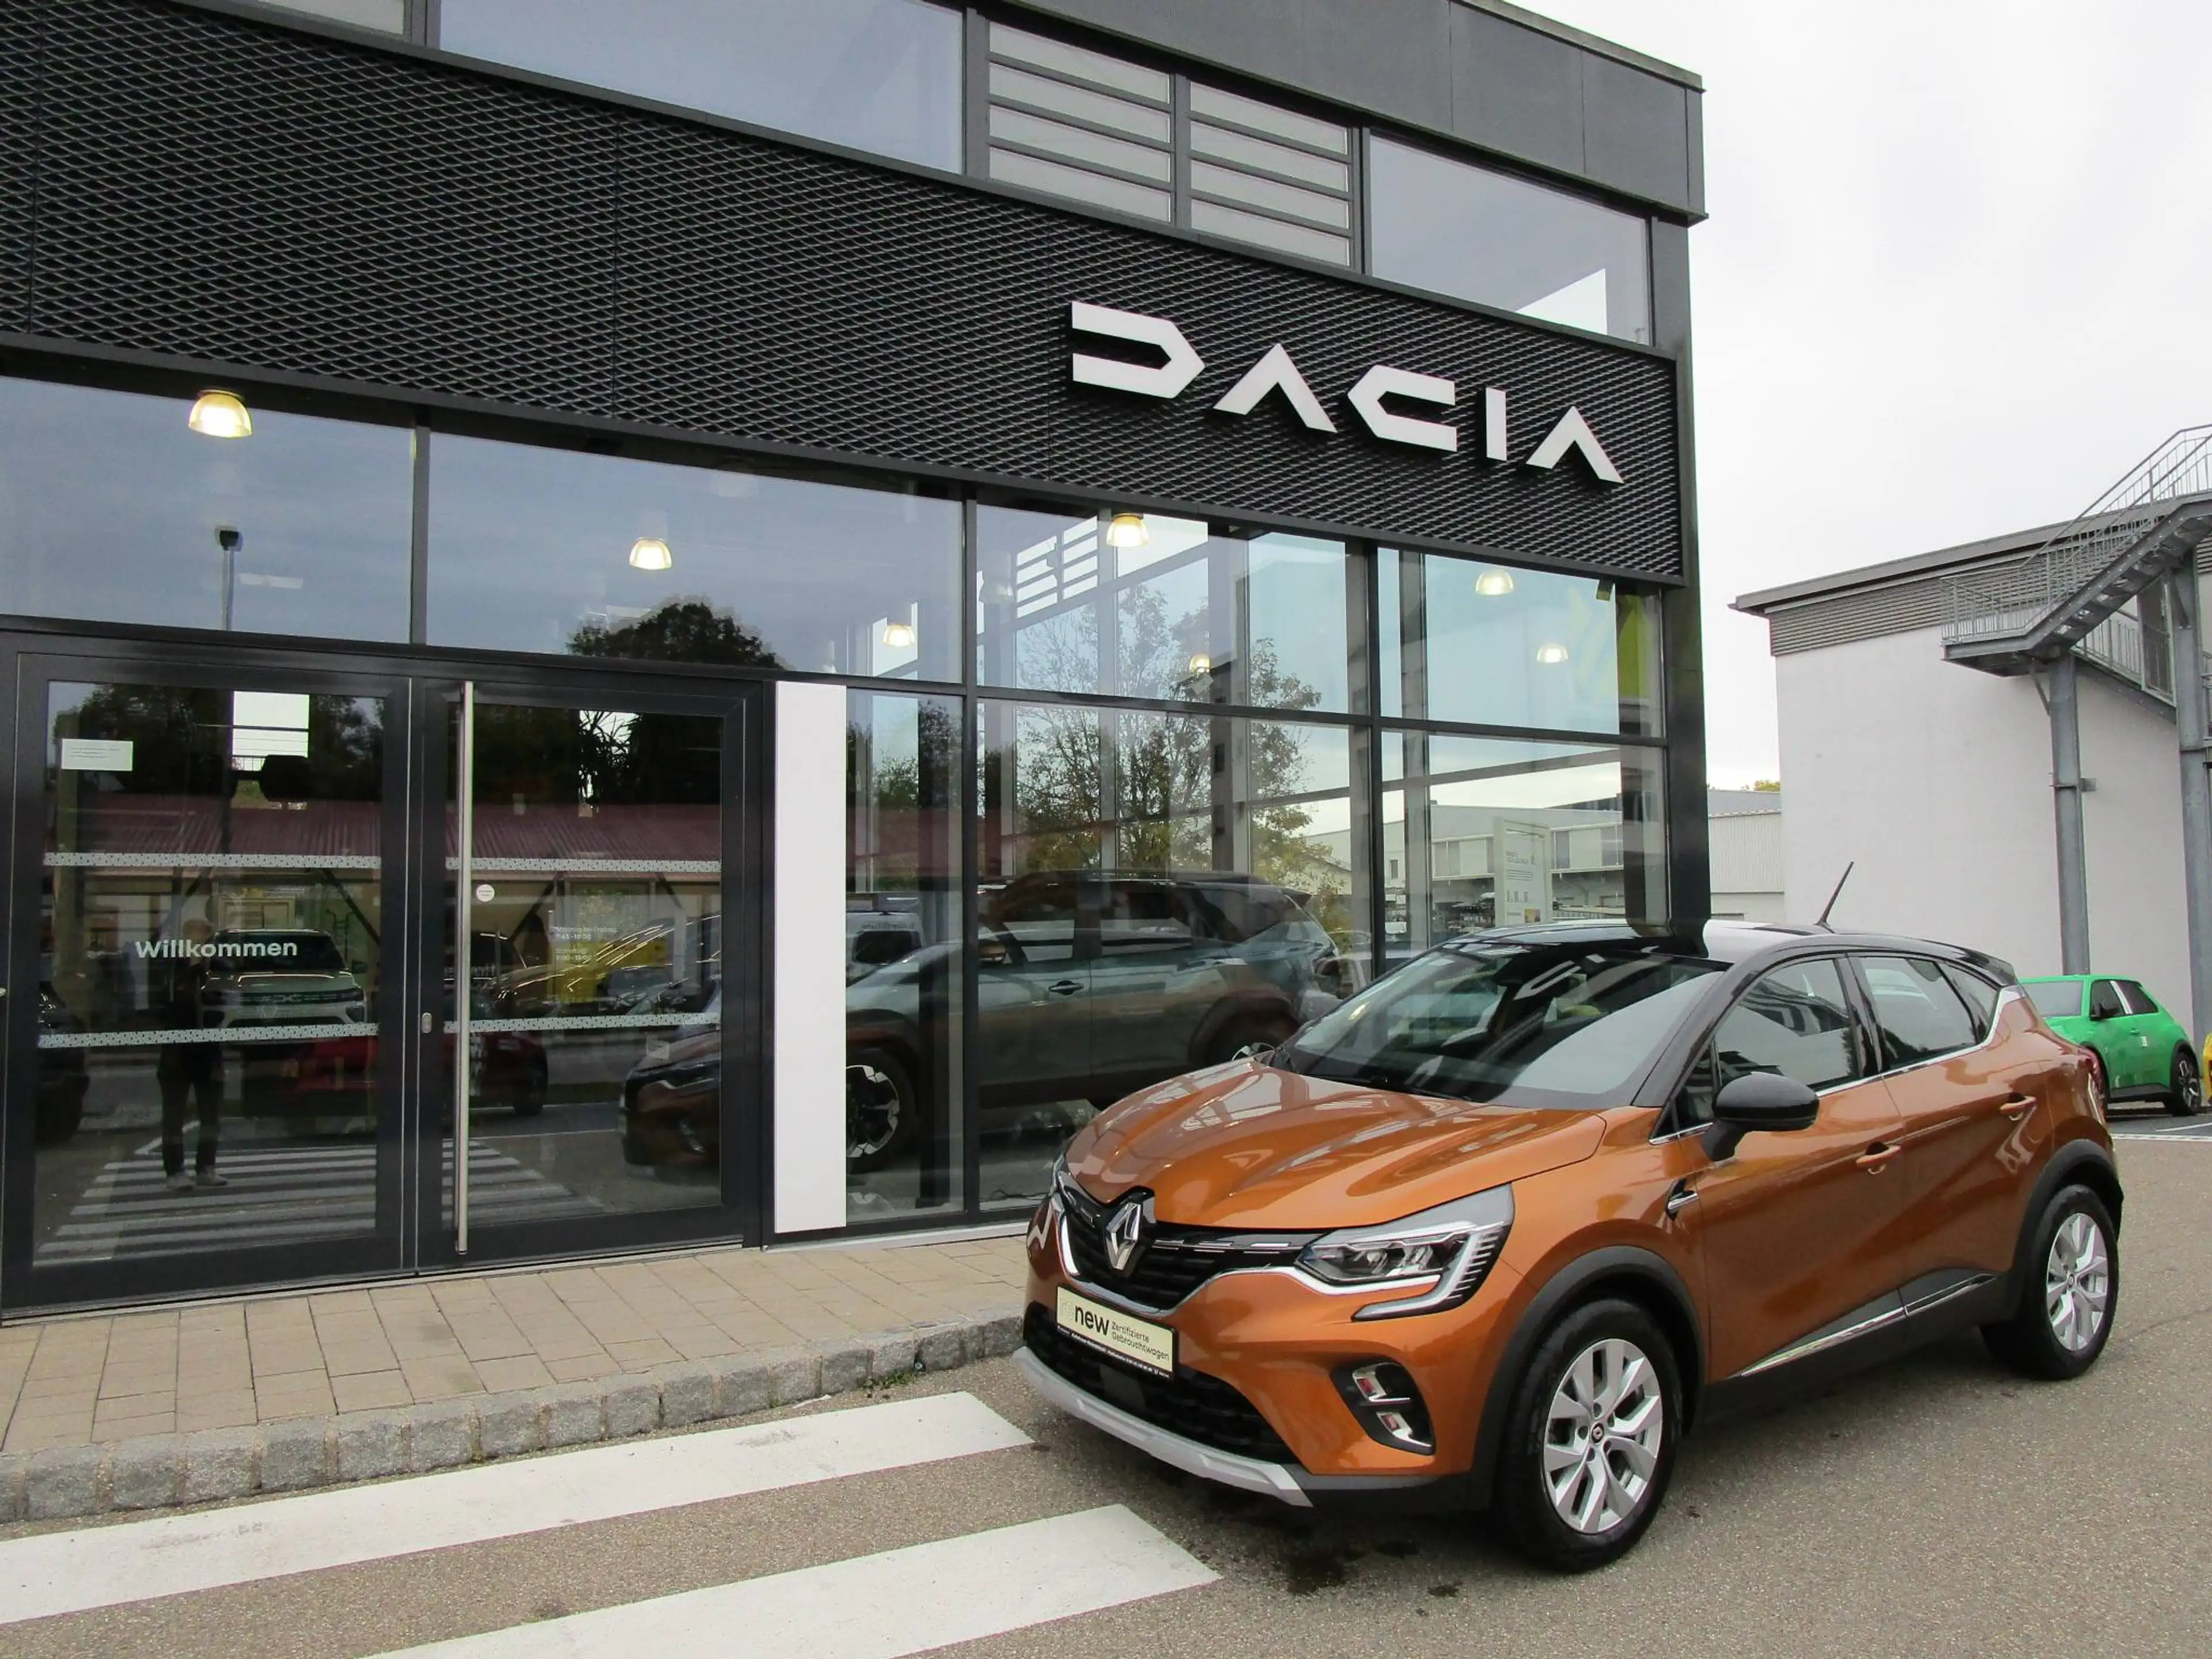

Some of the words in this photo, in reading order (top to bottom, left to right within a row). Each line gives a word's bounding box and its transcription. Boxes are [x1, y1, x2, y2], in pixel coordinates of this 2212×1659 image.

[1071, 301, 1624, 484] DACIA
[135, 940, 297, 958] Willkommen
[1111, 1322, 1150, 1343] Zertifizierte
